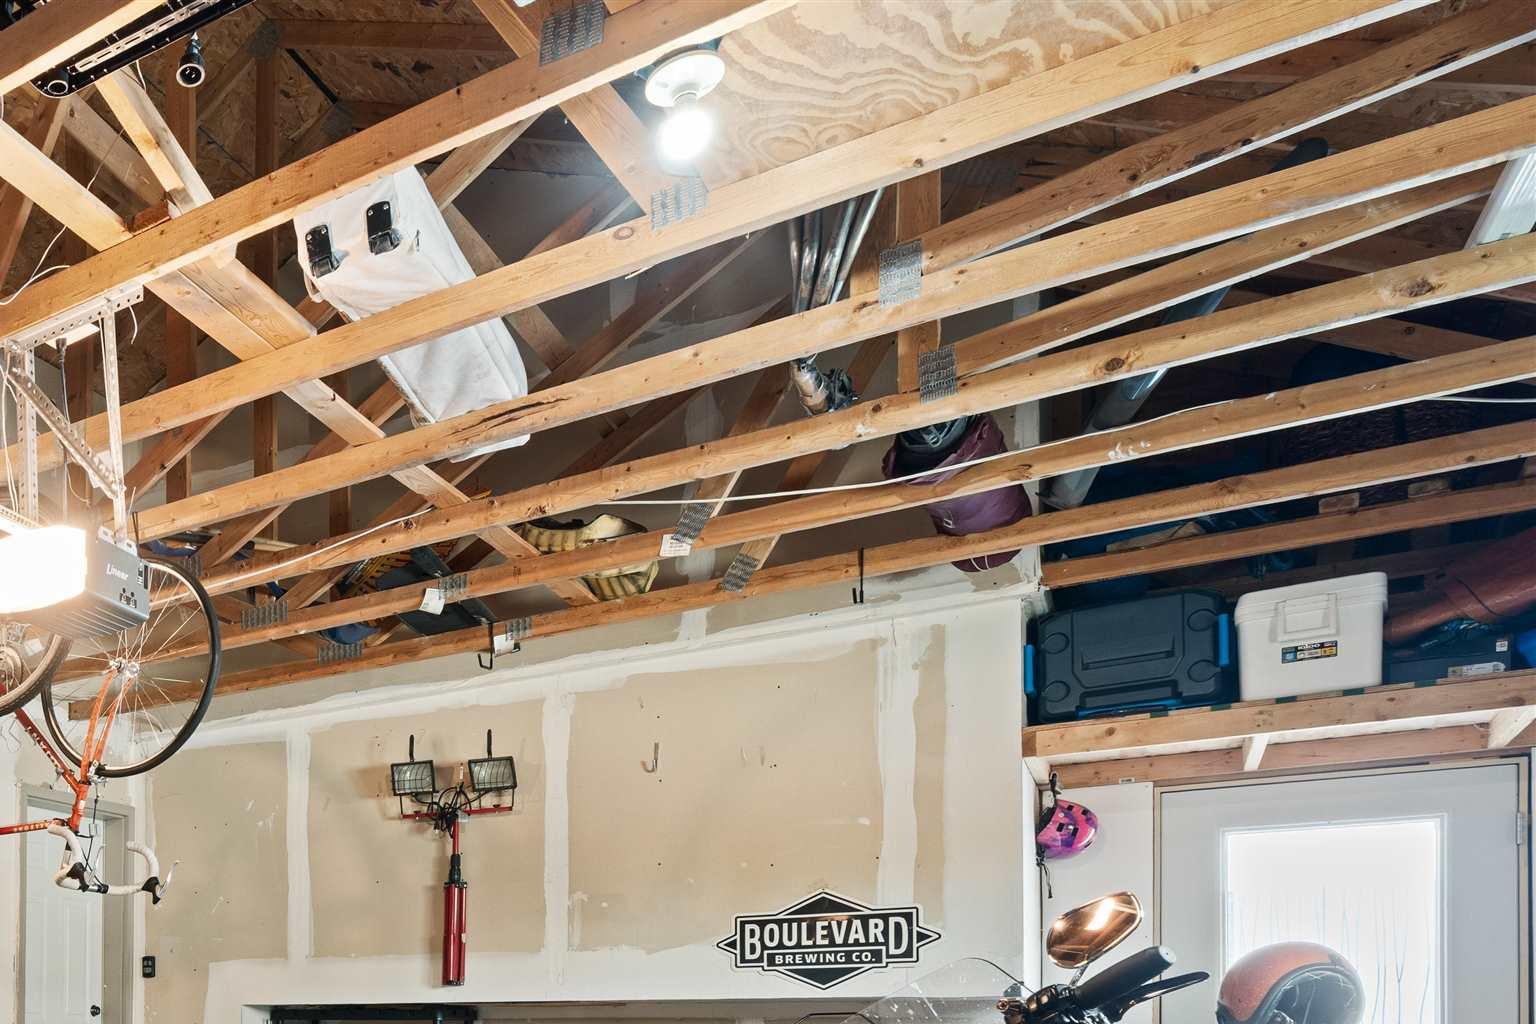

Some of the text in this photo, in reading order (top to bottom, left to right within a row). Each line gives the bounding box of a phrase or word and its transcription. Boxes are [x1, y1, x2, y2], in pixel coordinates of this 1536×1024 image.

[744, 916, 909, 960] BOULEVARD
[775, 952, 877, 965] BREWING CO.
